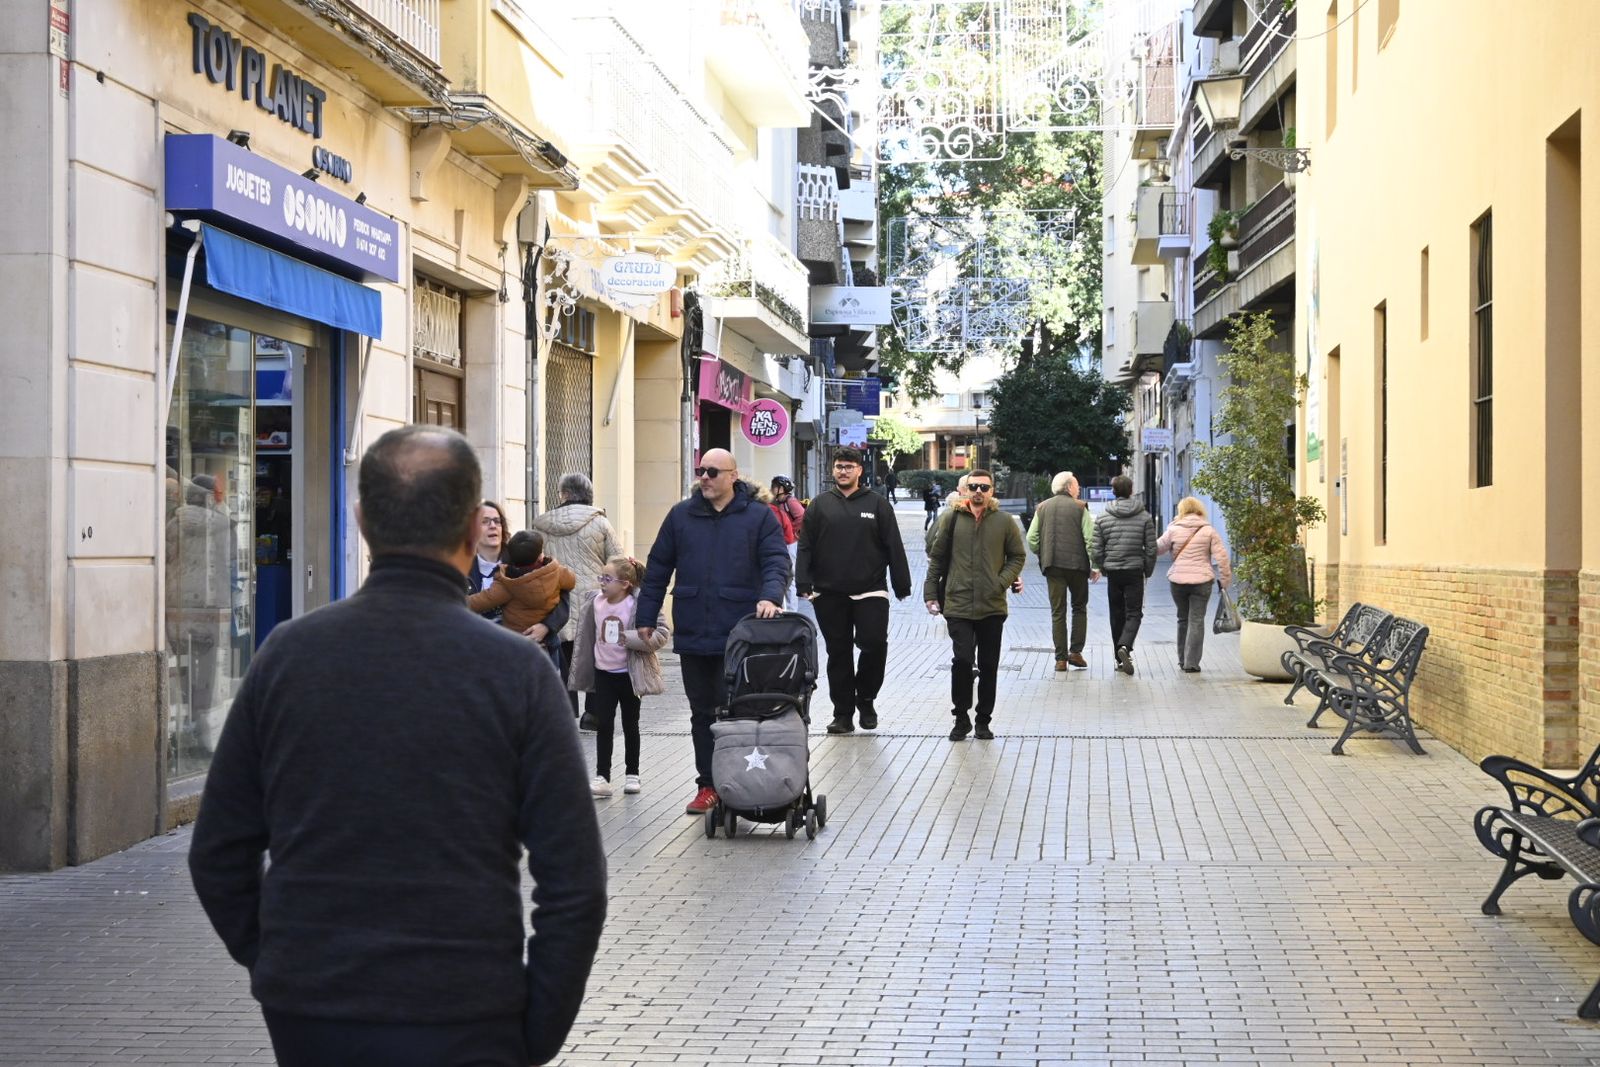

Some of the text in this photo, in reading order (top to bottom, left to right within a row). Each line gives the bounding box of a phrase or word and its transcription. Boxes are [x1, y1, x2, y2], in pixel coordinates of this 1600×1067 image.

[187, 12, 326, 139] TOY PLANET
[226, 163, 271, 206] JUGUETES
[312, 145, 352, 184] OSORNO
[283, 184, 347, 249] OSORNO
[614, 261, 661, 275] GAUDI
